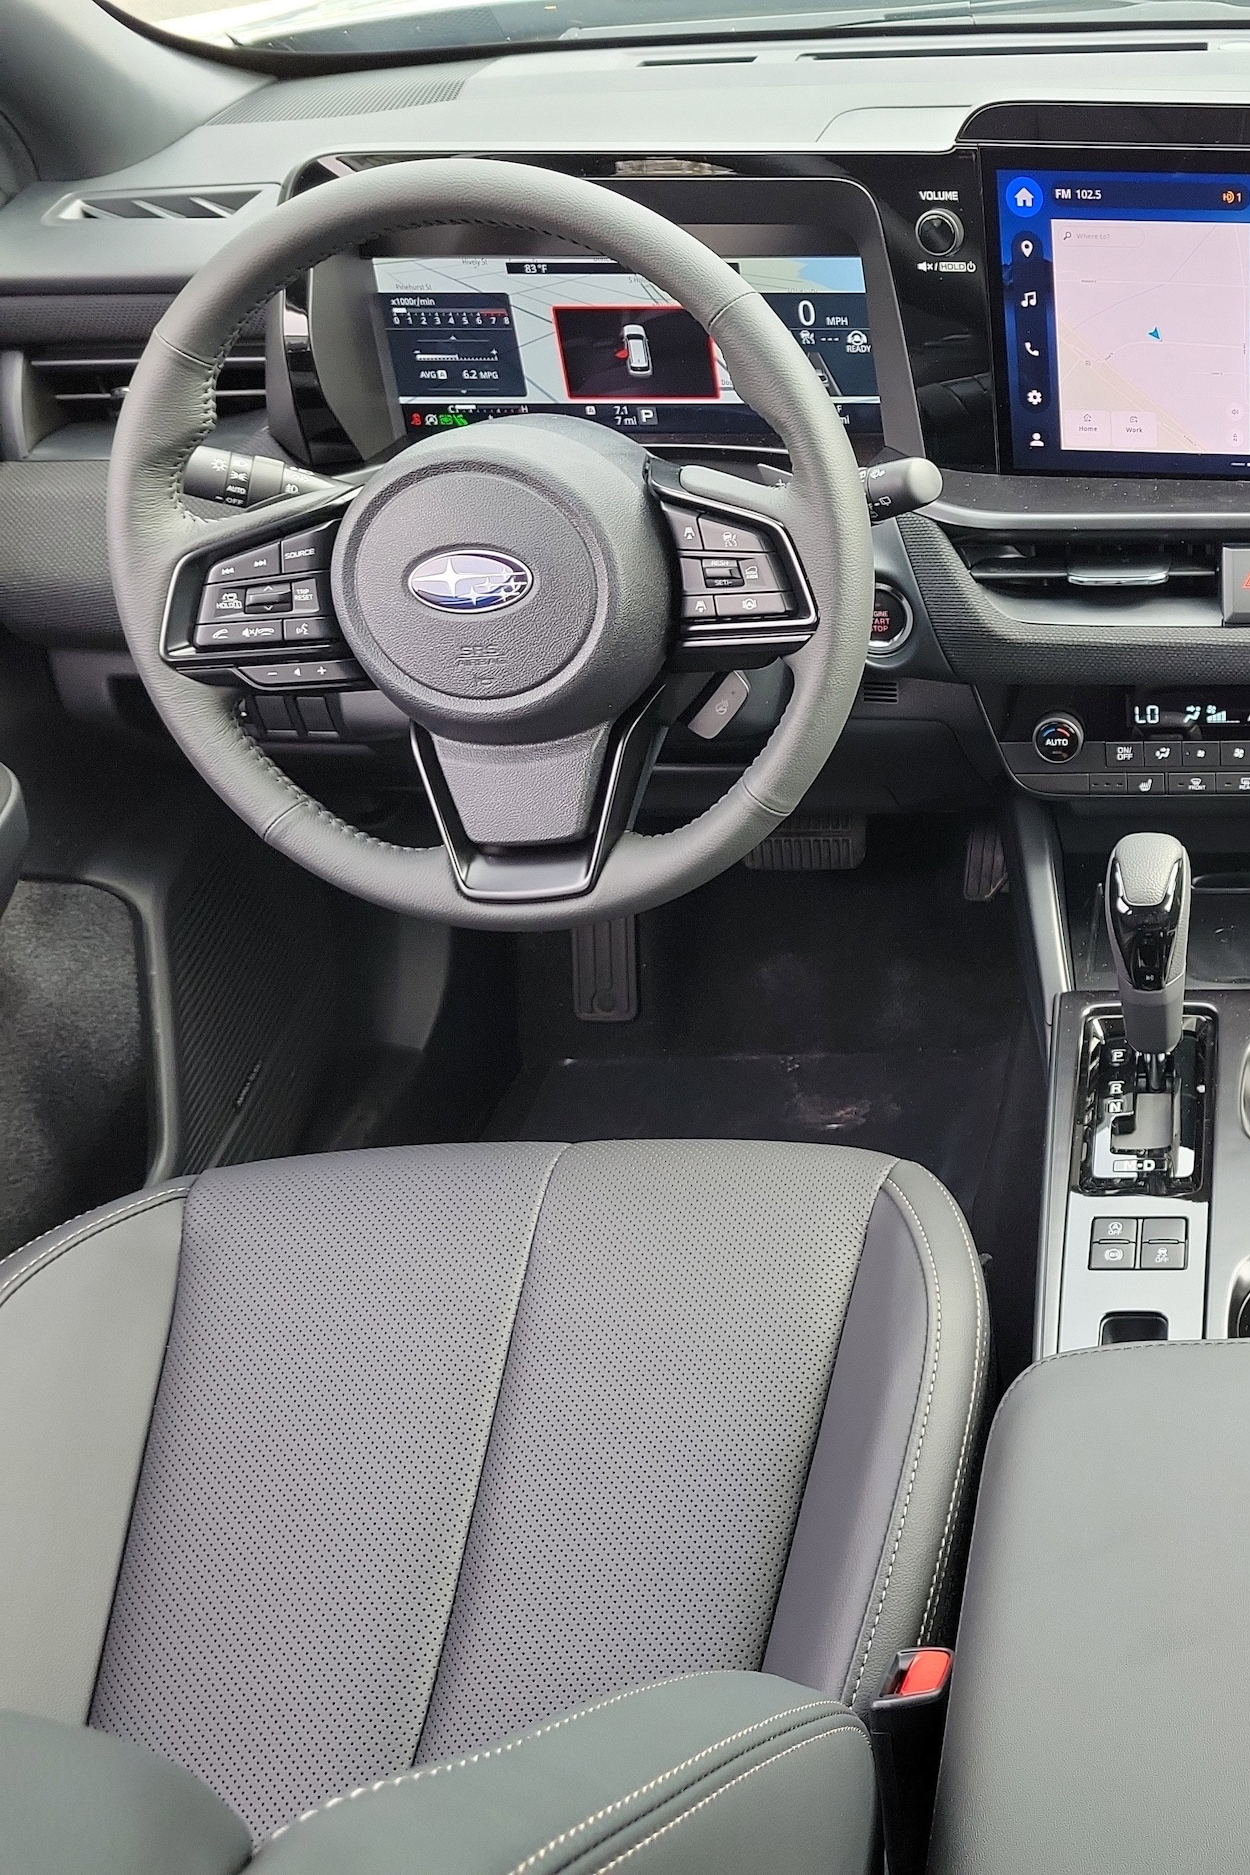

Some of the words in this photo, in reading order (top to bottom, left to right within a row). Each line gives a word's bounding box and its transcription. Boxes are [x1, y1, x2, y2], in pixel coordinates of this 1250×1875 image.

[919, 191, 958, 201] VOLUME
[1055, 189, 1072, 200] FM
[1076, 189, 1102, 200] 102.5
[940, 262, 966, 271] HOLD
[391, 297, 435, 306] x1000r/min
[798, 300, 815, 326] 0
[826, 316, 848, 326] MPH
[393, 317, 400, 325] 0
[407, 317, 412, 325] 1
[421, 317, 428, 325] 2
[434, 317, 441, 325] 3
[448, 317, 455, 325] 4
[462, 317, 469, 325] 5
[476, 317, 482, 325] 6
[490, 317, 496, 325] 7
[503, 317, 510, 325] 8
[846, 345, 871, 353] READY
[420, 371, 436, 379] AVG
[462, 370, 478, 379] 6.2
[479, 371, 498, 379] MPG
[614, 406, 628, 415] 7.1
[614, 416, 622, 425] 7
[624, 416, 637, 425] mi
[640, 410, 654, 422] P
[226, 485, 246, 494] AUTO
[226, 497, 244, 505] OFF
[284, 548, 315, 560] SOURCE
[1134, 705, 1159, 724] LO
[1045, 738, 1068, 746] AUTO
[1112, 1052, 1124, 1062] P
[1109, 1084, 1123, 1095] R
[1108, 1102, 1122, 1113] N
